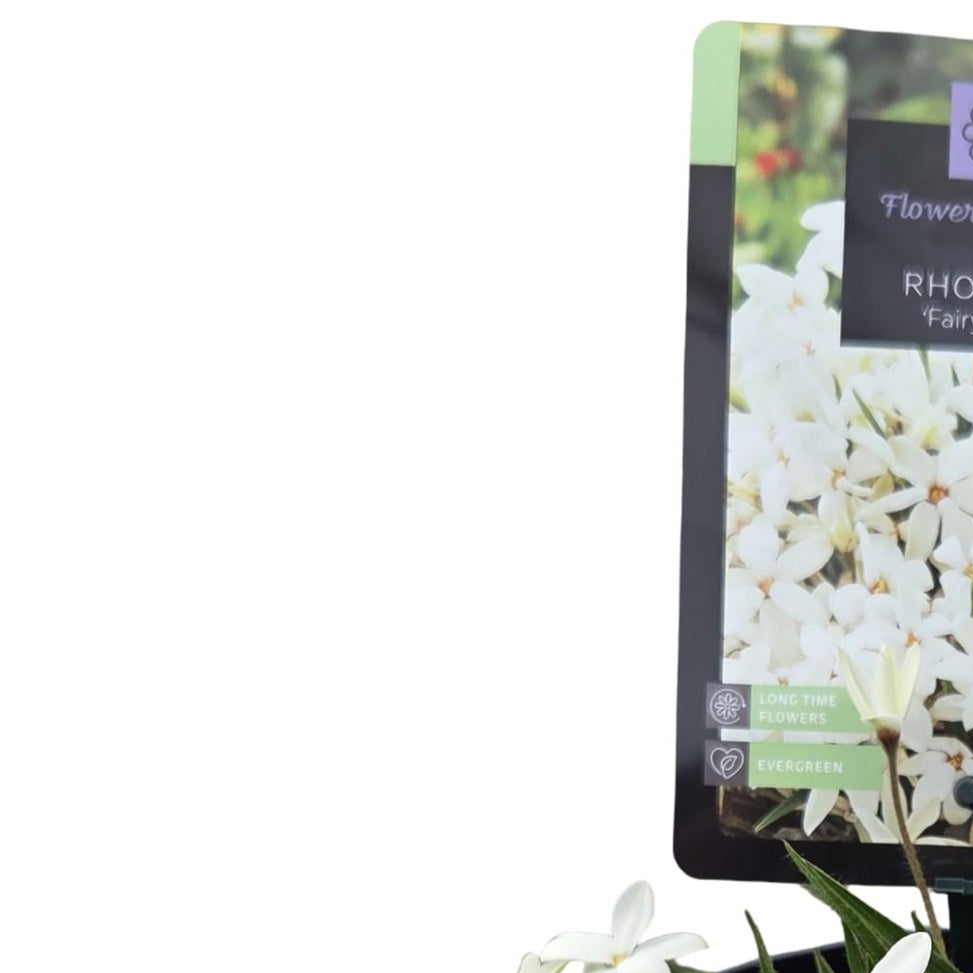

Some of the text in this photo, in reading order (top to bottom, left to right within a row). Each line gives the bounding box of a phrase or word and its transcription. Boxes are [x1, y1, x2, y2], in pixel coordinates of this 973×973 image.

[759, 692, 837, 707] LONG TIME
[759, 711, 827, 725] FLOWERS
[758, 759, 843, 774] EVERGREEN
